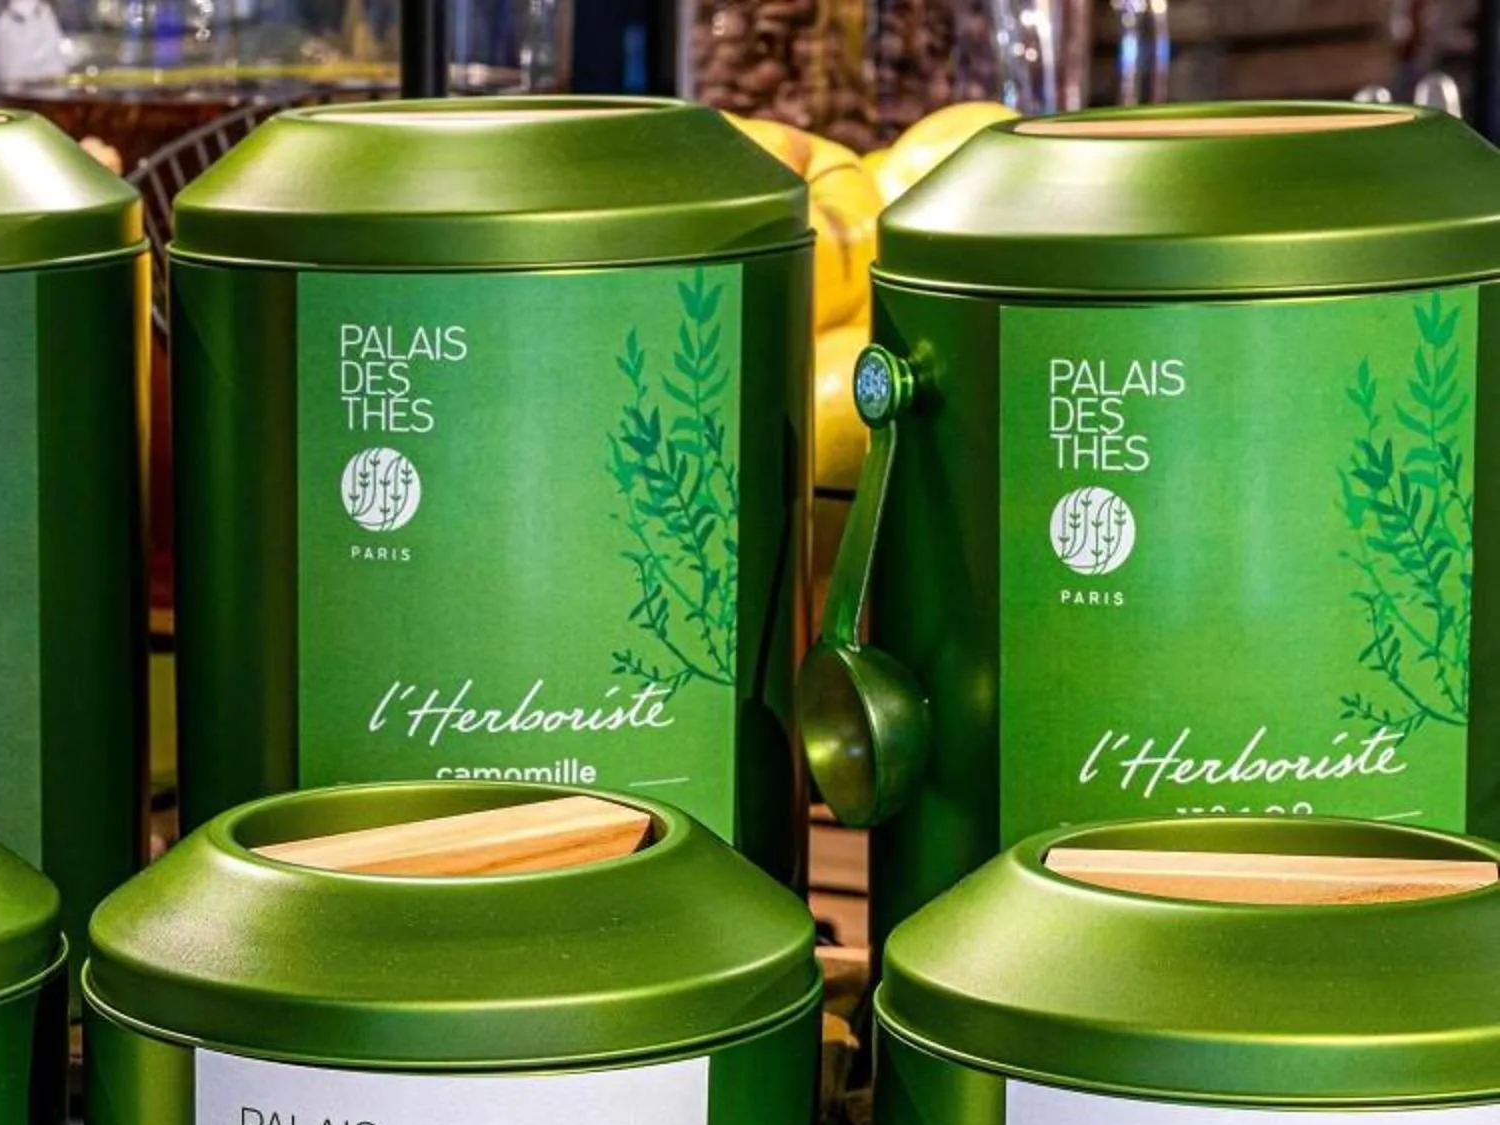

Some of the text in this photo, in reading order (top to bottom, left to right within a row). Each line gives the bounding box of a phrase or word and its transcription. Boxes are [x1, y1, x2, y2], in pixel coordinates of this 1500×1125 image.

[340, 325, 467, 361] PALAIS
[341, 361, 410, 397] DES
[1049, 359, 1185, 396] PALAIS
[341, 394, 434, 433] THÉS
[1049, 398, 1124, 434] DES
[1049, 430, 1149, 471] THÉS
[351, 546, 411, 562] PARIS
[1060, 590, 1125, 606] PARIS
